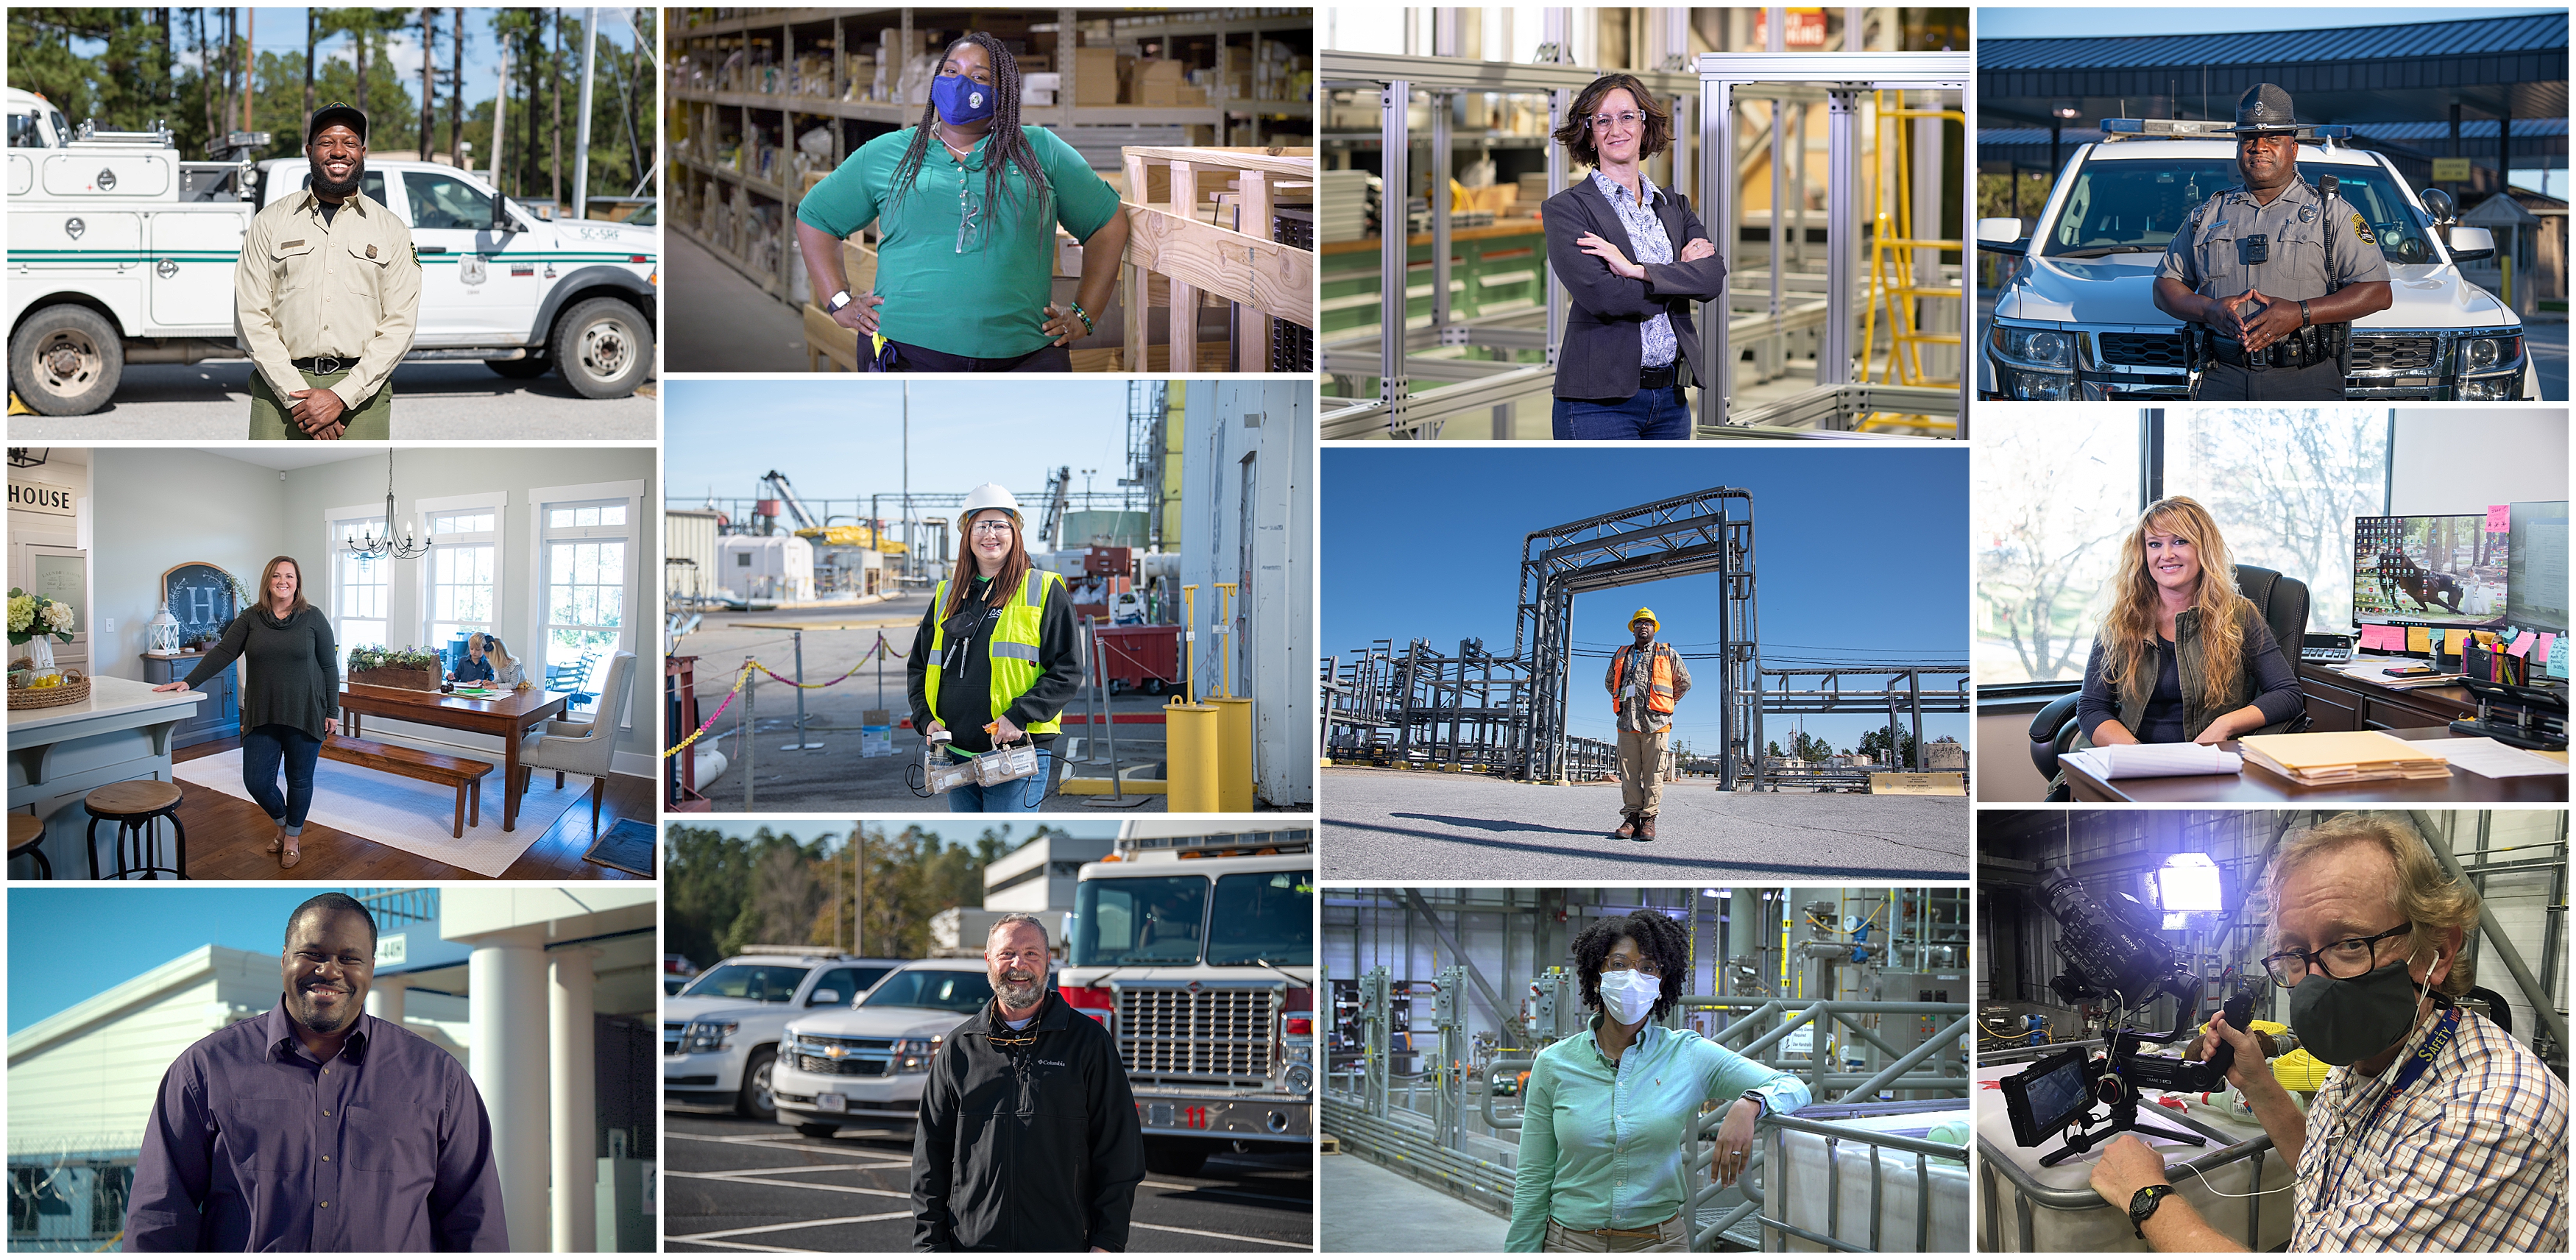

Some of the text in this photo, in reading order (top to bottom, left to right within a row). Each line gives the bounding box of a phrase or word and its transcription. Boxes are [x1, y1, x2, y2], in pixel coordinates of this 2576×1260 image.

[1756, 24, 1825, 44] SKING
[8, 484, 70, 509] HOUSE
[186, 587, 217, 625] H
[2120, 934, 2138, 951] SONY
[2117, 955, 2127, 964] 4K
[2418, 1026, 2452, 1062] SAFETY
[1183, 1105, 1206, 1128] 11
